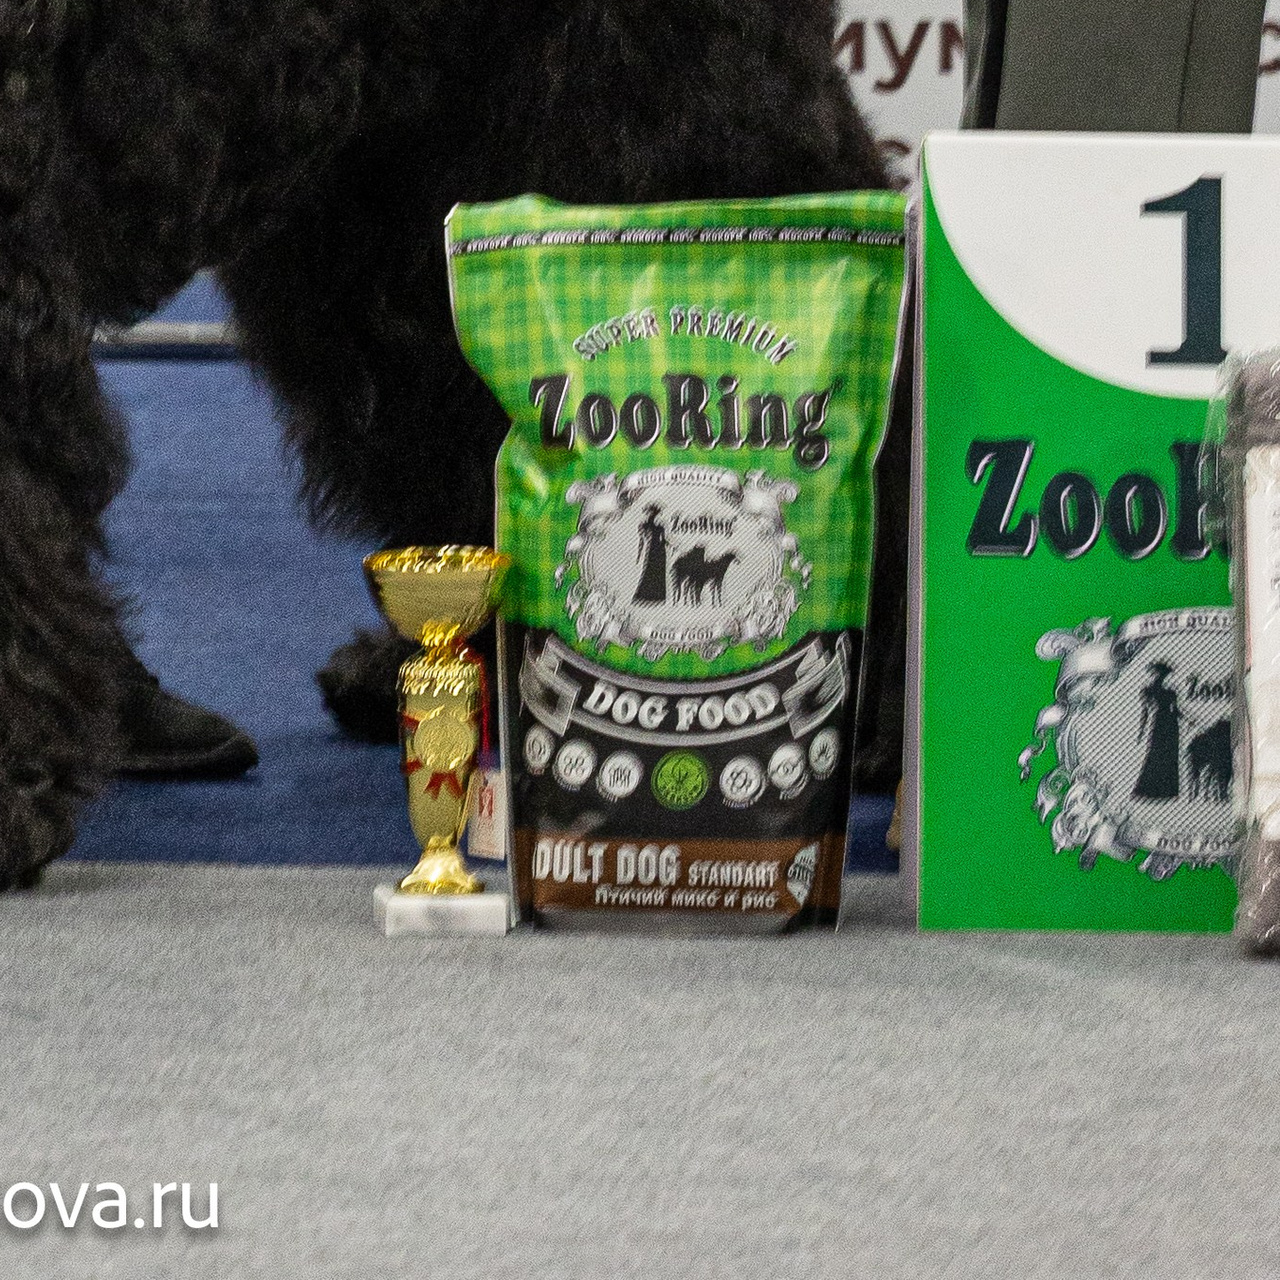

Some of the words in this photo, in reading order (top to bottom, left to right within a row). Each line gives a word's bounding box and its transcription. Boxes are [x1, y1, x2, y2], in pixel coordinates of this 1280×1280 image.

[1141, 174, 1228, 367] 1
[573, 306, 660, 361] SUPER
[530, 373, 831, 472] ZooRing
[582, 678, 670, 730] DOG
[675, 682, 781, 732] FOOD
[617, 842, 681, 887] DOG
[688, 860, 778, 888] STANDART
